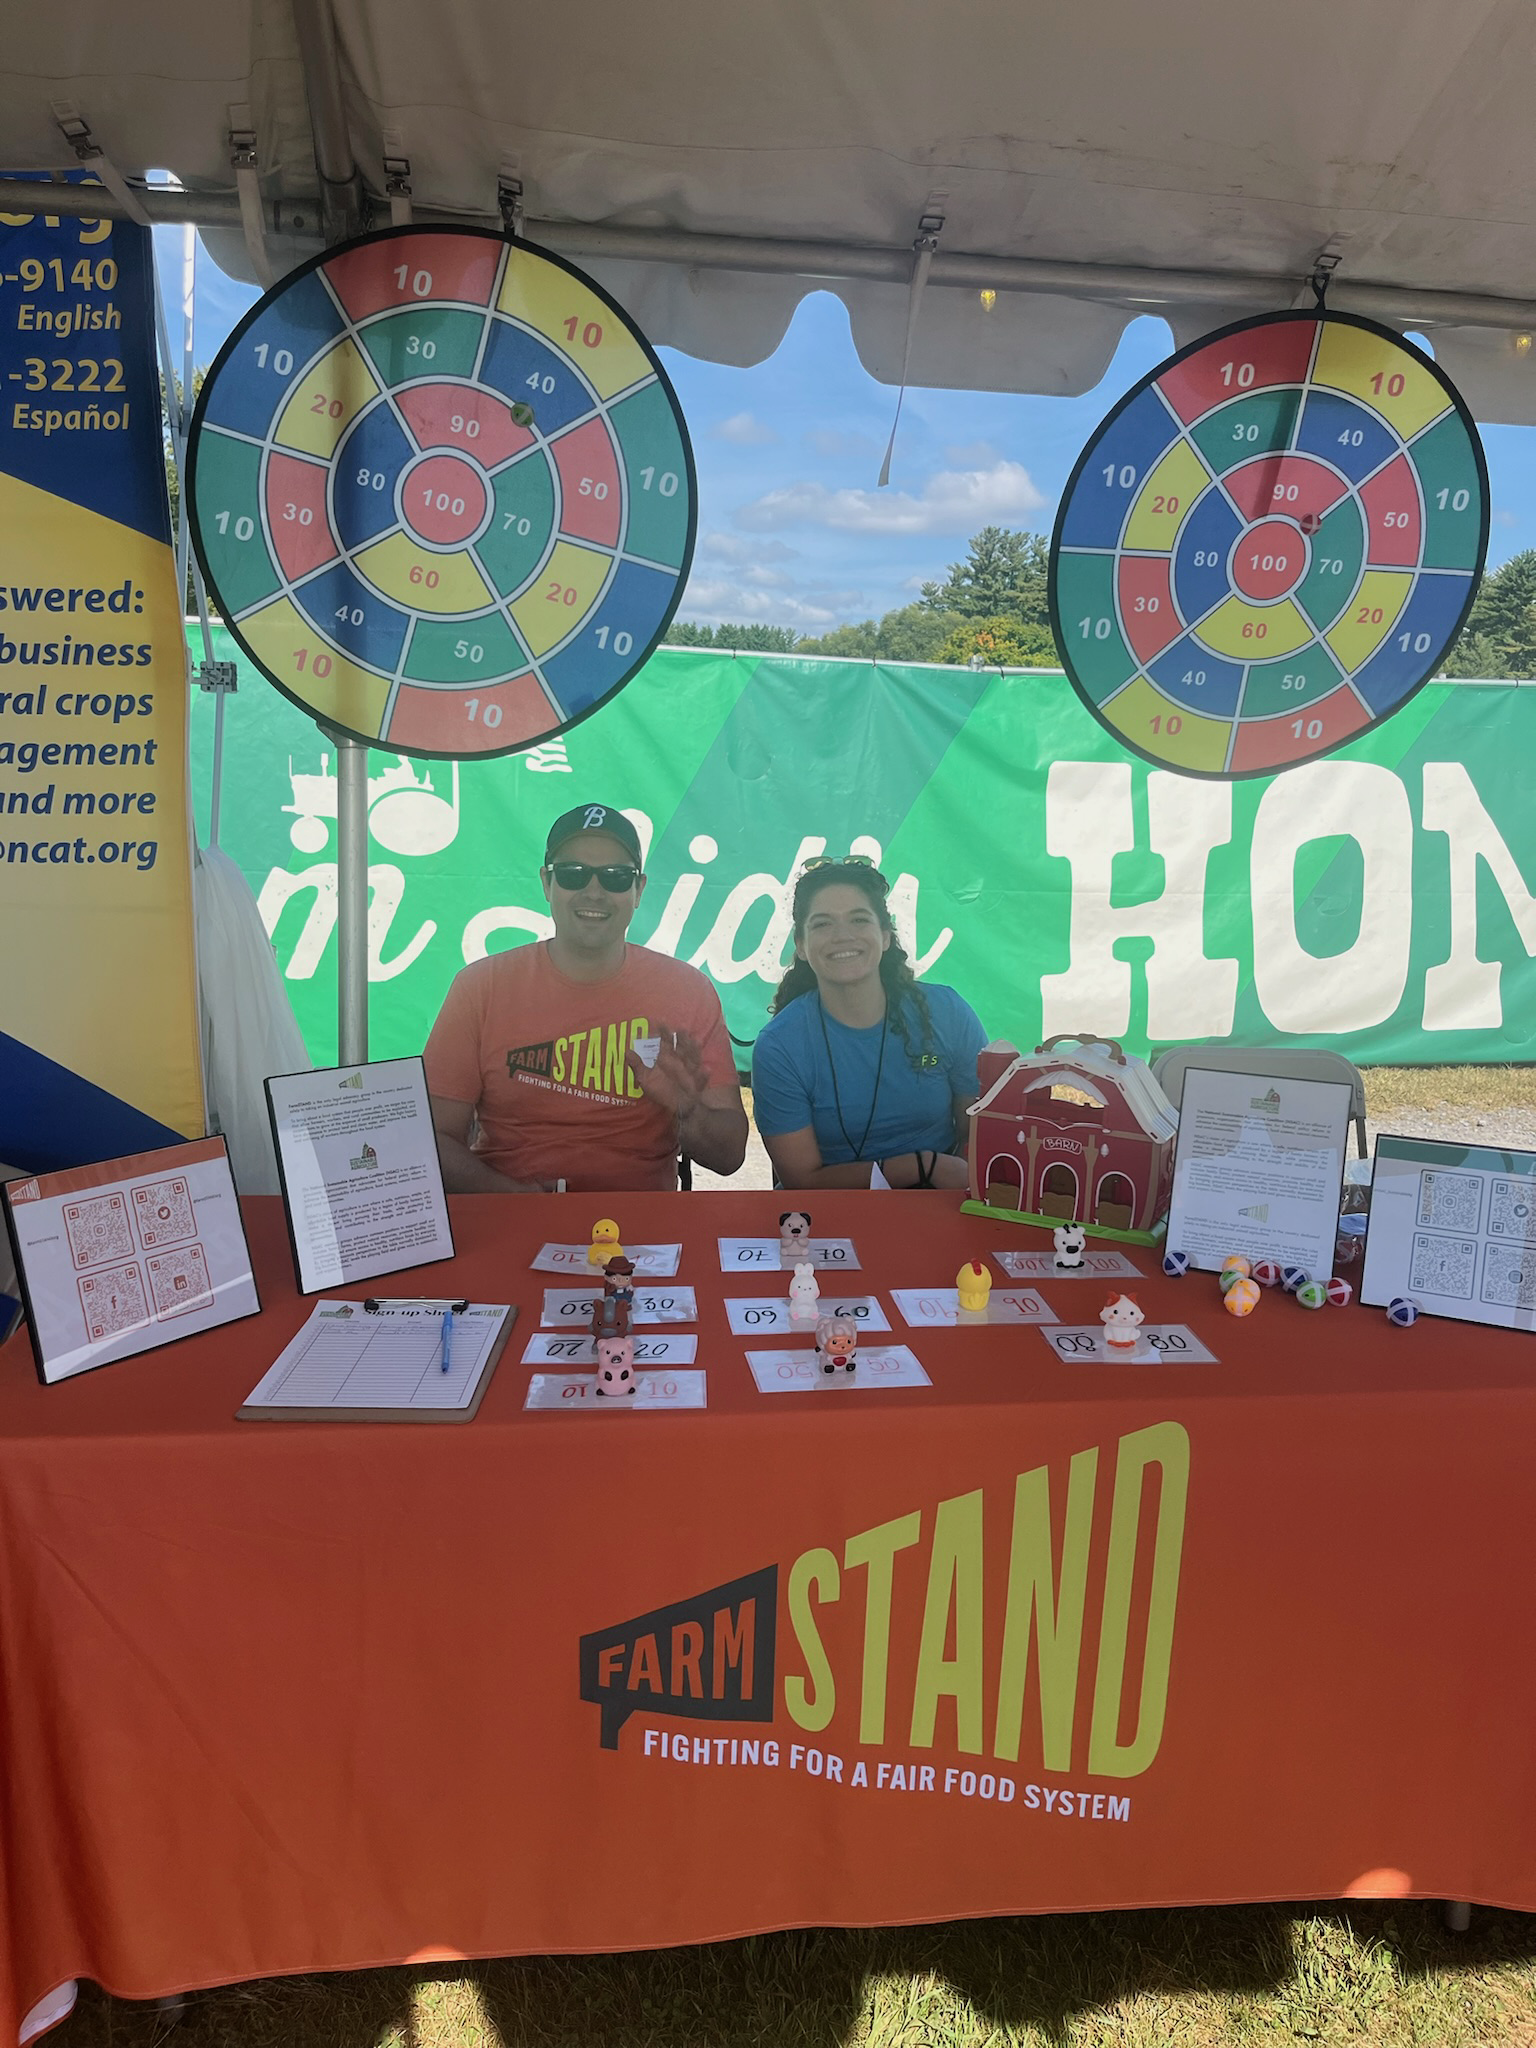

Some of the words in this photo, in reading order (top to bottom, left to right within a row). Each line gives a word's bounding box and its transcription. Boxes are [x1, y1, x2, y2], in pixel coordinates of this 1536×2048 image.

[0, 258, 119, 292] -9140
[393, 263, 434, 298] 10
[17, 303, 122, 338] English
[562, 315, 605, 350] 10
[252, 342, 295, 377] 10
[405, 335, 437, 361] 30
[0, 358, 127, 392] -3222
[524, 370, 558, 396] 40
[1218, 361, 1256, 388] 10
[1368, 371, 1407, 397] 10
[12, 403, 130, 436] Español
[309, 393, 345, 421] 20
[449, 414, 482, 439] 90
[1231, 423, 1260, 443] 30
[1337, 428, 1365, 448] 40
[355, 466, 388, 492] 80
[577, 476, 610, 502] 50
[639, 465, 680, 499] 10
[1101, 463, 1137, 490] 10
[421, 488, 467, 518] 100
[1150, 495, 1180, 515] 20
[1271, 483, 1301, 502] 90
[1435, 487, 1471, 512] 10
[213, 509, 256, 543] 10
[281, 502, 315, 527] 30
[501, 512, 533, 537] 70
[1382, 510, 1410, 530] 50
[1192, 550, 1220, 569] 80
[1248, 554, 1288, 573] 100
[1317, 557, 1344, 576] 70
[407, 565, 441, 591] 60
[545, 582, 579, 608] 20
[1133, 596, 1160, 614] 30
[334, 604, 366, 628] 40
[1077, 616, 1112, 641] 10
[1355, 607, 1385, 625] 20
[593, 624, 634, 657] 10
[1240, 622, 1268, 640] 60
[1396, 632, 1432, 654] 10
[0, 633, 152, 667] business
[452, 639, 485, 664] 50
[291, 648, 334, 680] 10
[1181, 670, 1207, 688] 40
[1280, 674, 1307, 692] 50
[55, 693, 154, 724] crops
[463, 698, 505, 730] 10
[1148, 714, 1184, 737] 10
[1290, 719, 1325, 741] 10
[0, 738, 158, 773] agement
[0, 784, 56, 815] nd
[62, 791, 157, 815] more
[582, 806, 607, 829] B
[510, 1047, 549, 1072] FARM
[518, 1073, 551, 1090] FIGHTING
[553, 1084, 567, 1095] FOR
[574, 1089, 590, 1100] FAIR
[591, 1093, 610, 1105] FOOD
[1046, 1137, 1079, 1152] BARN
[818, 1248, 846, 1260] 70
[1085, 1257, 1121, 1271] 100
[642, 1297, 676, 1312] 30
[1002, 1296, 1041, 1314] 90
[546, 1340, 585, 1356] 20
[634, 1342, 670, 1357] 20
[1146, 1333, 1188, 1350] 80
[867, 1356, 901, 1372] 50
[561, 1385, 587, 1399] 10
[647, 1381, 678, 1396] 10
[598, 1597, 757, 1702] FARM
[784, 1420, 1192, 1779] STAND
[643, 1729, 780, 1767] FIGHTING
[789, 1744, 844, 1784] FOR
[850, 1760, 870, 1788] A
[876, 1762, 936, 1792] FAIR
[944, 1768, 1015, 1805] FOOD
[1024, 1784, 1132, 1823] SYSTEM
